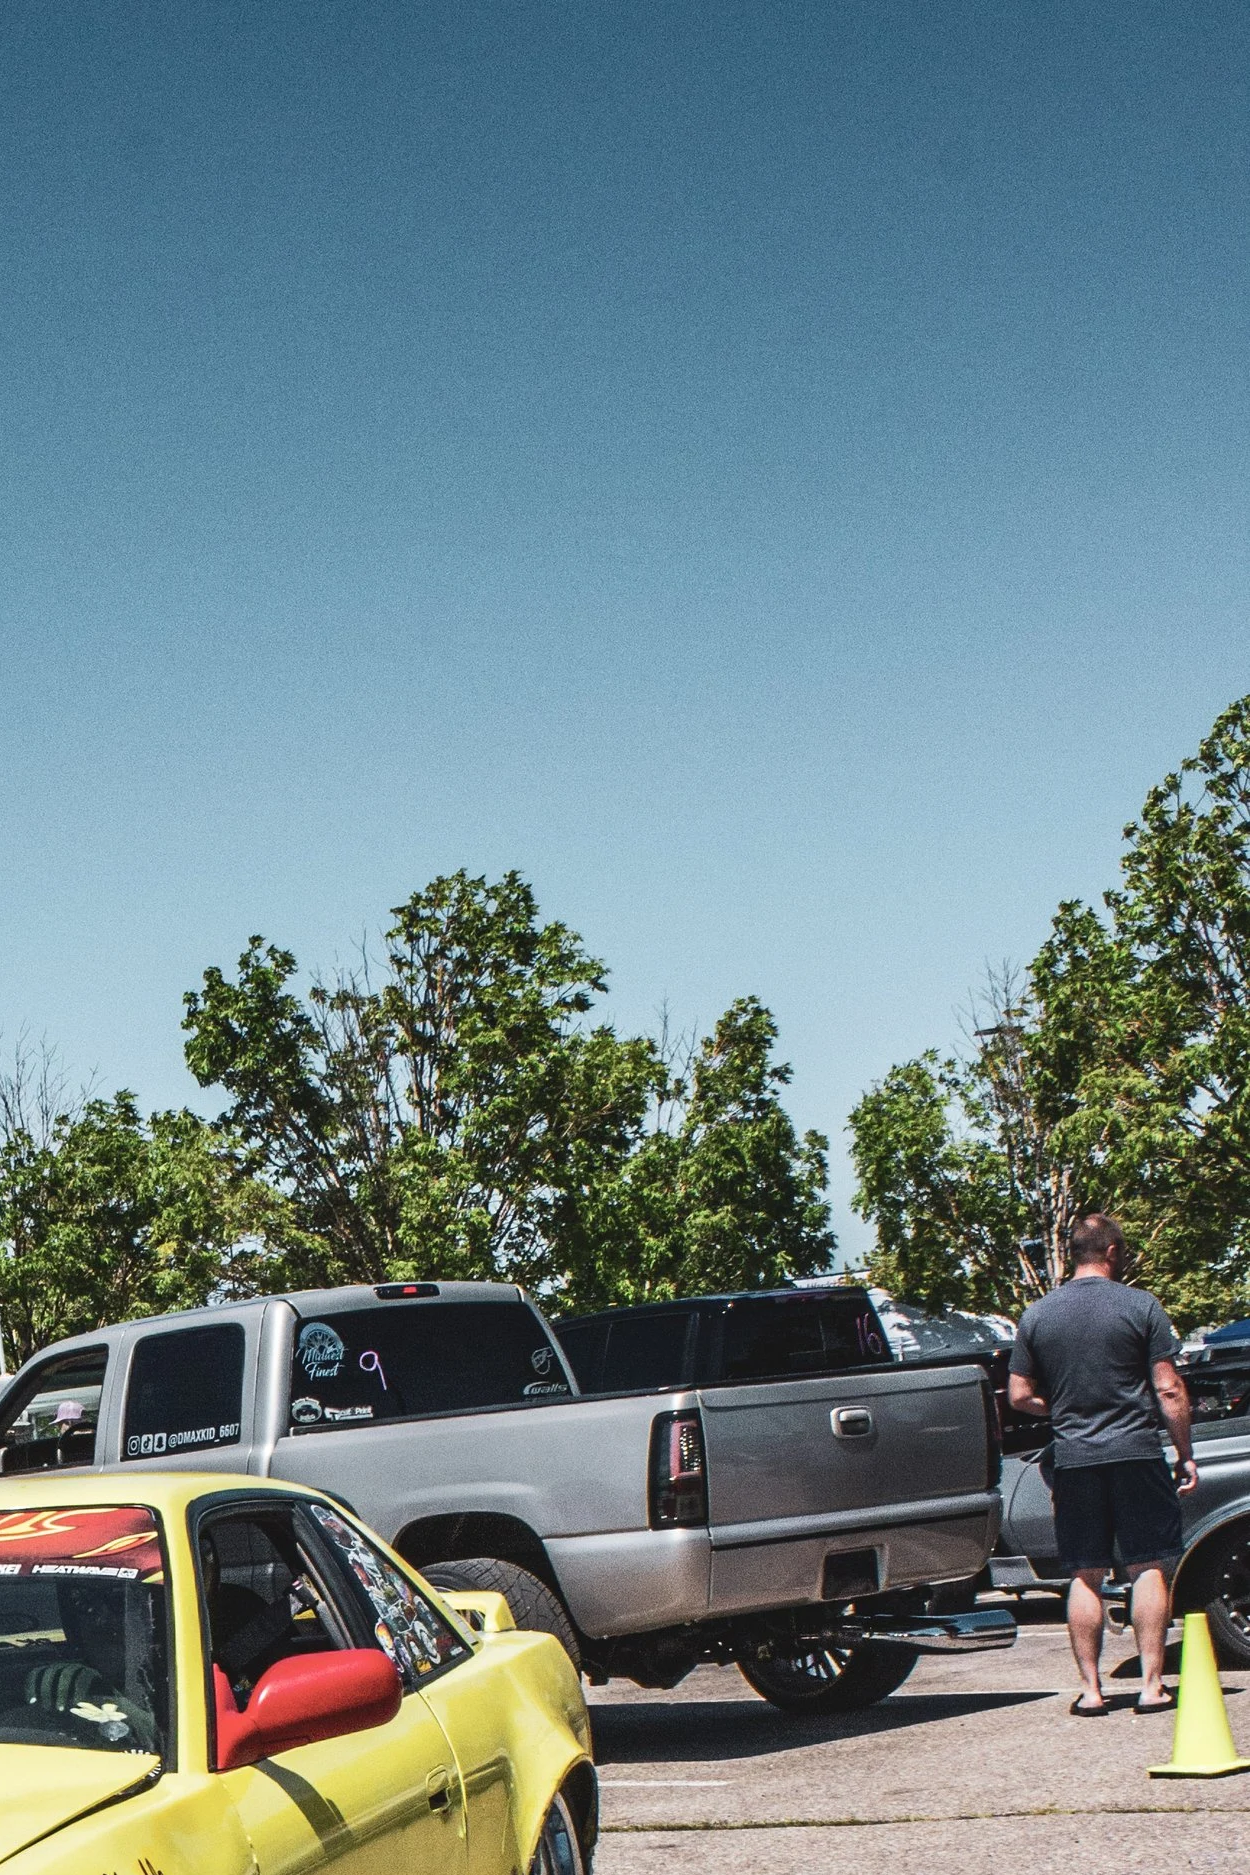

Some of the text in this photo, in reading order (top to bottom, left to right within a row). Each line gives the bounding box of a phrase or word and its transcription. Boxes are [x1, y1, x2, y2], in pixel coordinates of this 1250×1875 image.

[295, 1345, 349, 1365] Midwest
[304, 1361, 345, 1381] Finest
[359, 1350, 387, 1391] 9
[168, 1423, 240, 1448] @DMAXKID_6607
[31, 1564, 120, 1578] HEATWAVE
